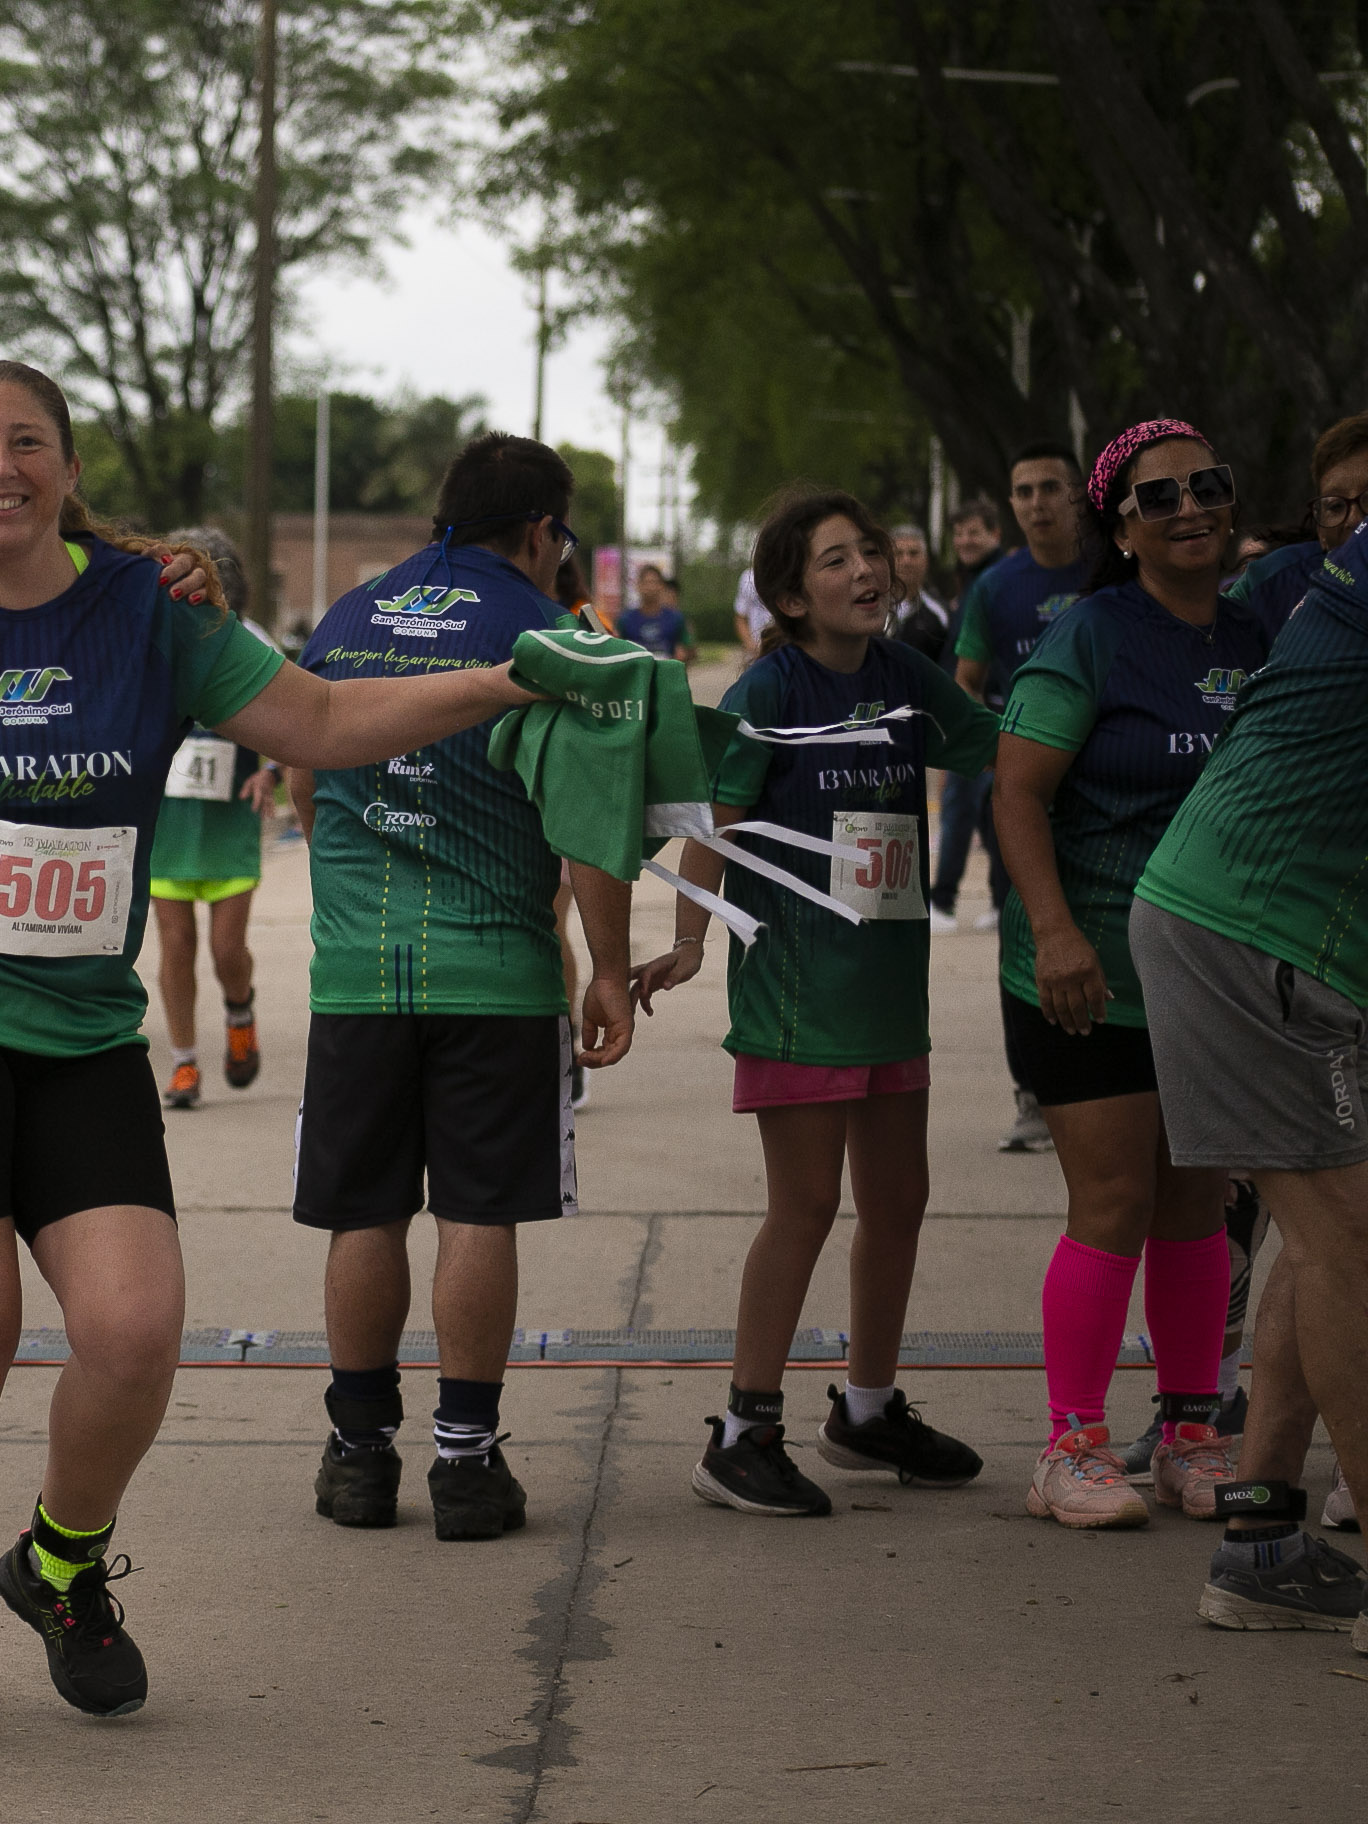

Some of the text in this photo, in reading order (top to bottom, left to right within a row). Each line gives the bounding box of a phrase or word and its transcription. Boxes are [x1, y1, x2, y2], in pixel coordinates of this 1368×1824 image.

[371, 614, 466, 630] San Jerónimo Sud
[393, 628, 438, 637] COMUNA
[384, 648, 428, 672] lugar
[427, 656, 462, 674] para
[465, 658, 493, 670] vivi
[0, 705, 50, 716] Jerónimo
[49, 703, 72, 715] Sud
[2, 717, 48, 725] COMUNA
[188, 754, 216, 784] 41
[387, 761, 421, 775] Run
[855, 838, 914, 890] 506
[11, 921, 57, 934] ALTAMIRANO
[1329, 1053, 1356, 1131] JORDA
